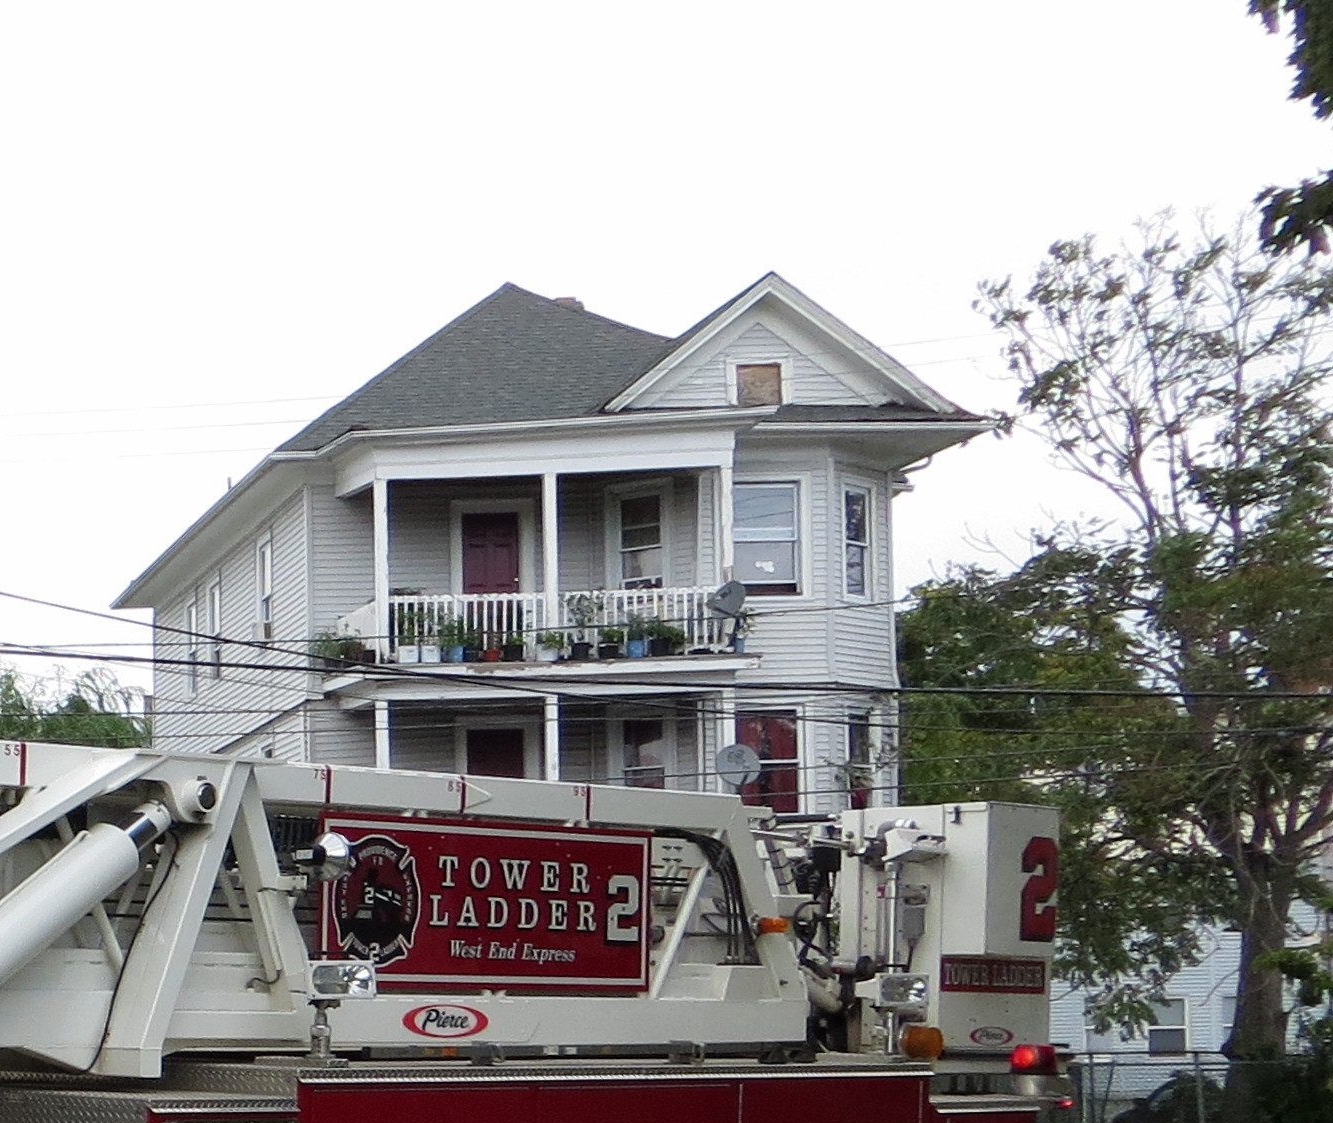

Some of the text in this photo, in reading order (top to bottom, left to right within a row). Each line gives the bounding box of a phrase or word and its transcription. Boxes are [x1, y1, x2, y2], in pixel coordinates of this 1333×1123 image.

[4, 744, 21, 756] 55
[438, 855, 591, 893] TOWER
[1020, 836, 1059, 942] 2
[429, 894, 597, 931] LADDER
[607, 874, 640, 942] 2
[450, 939, 576, 965] West End Express
[944, 962, 1043, 987] TOWER LADDER
[422, 1008, 470, 1031] Pierce
